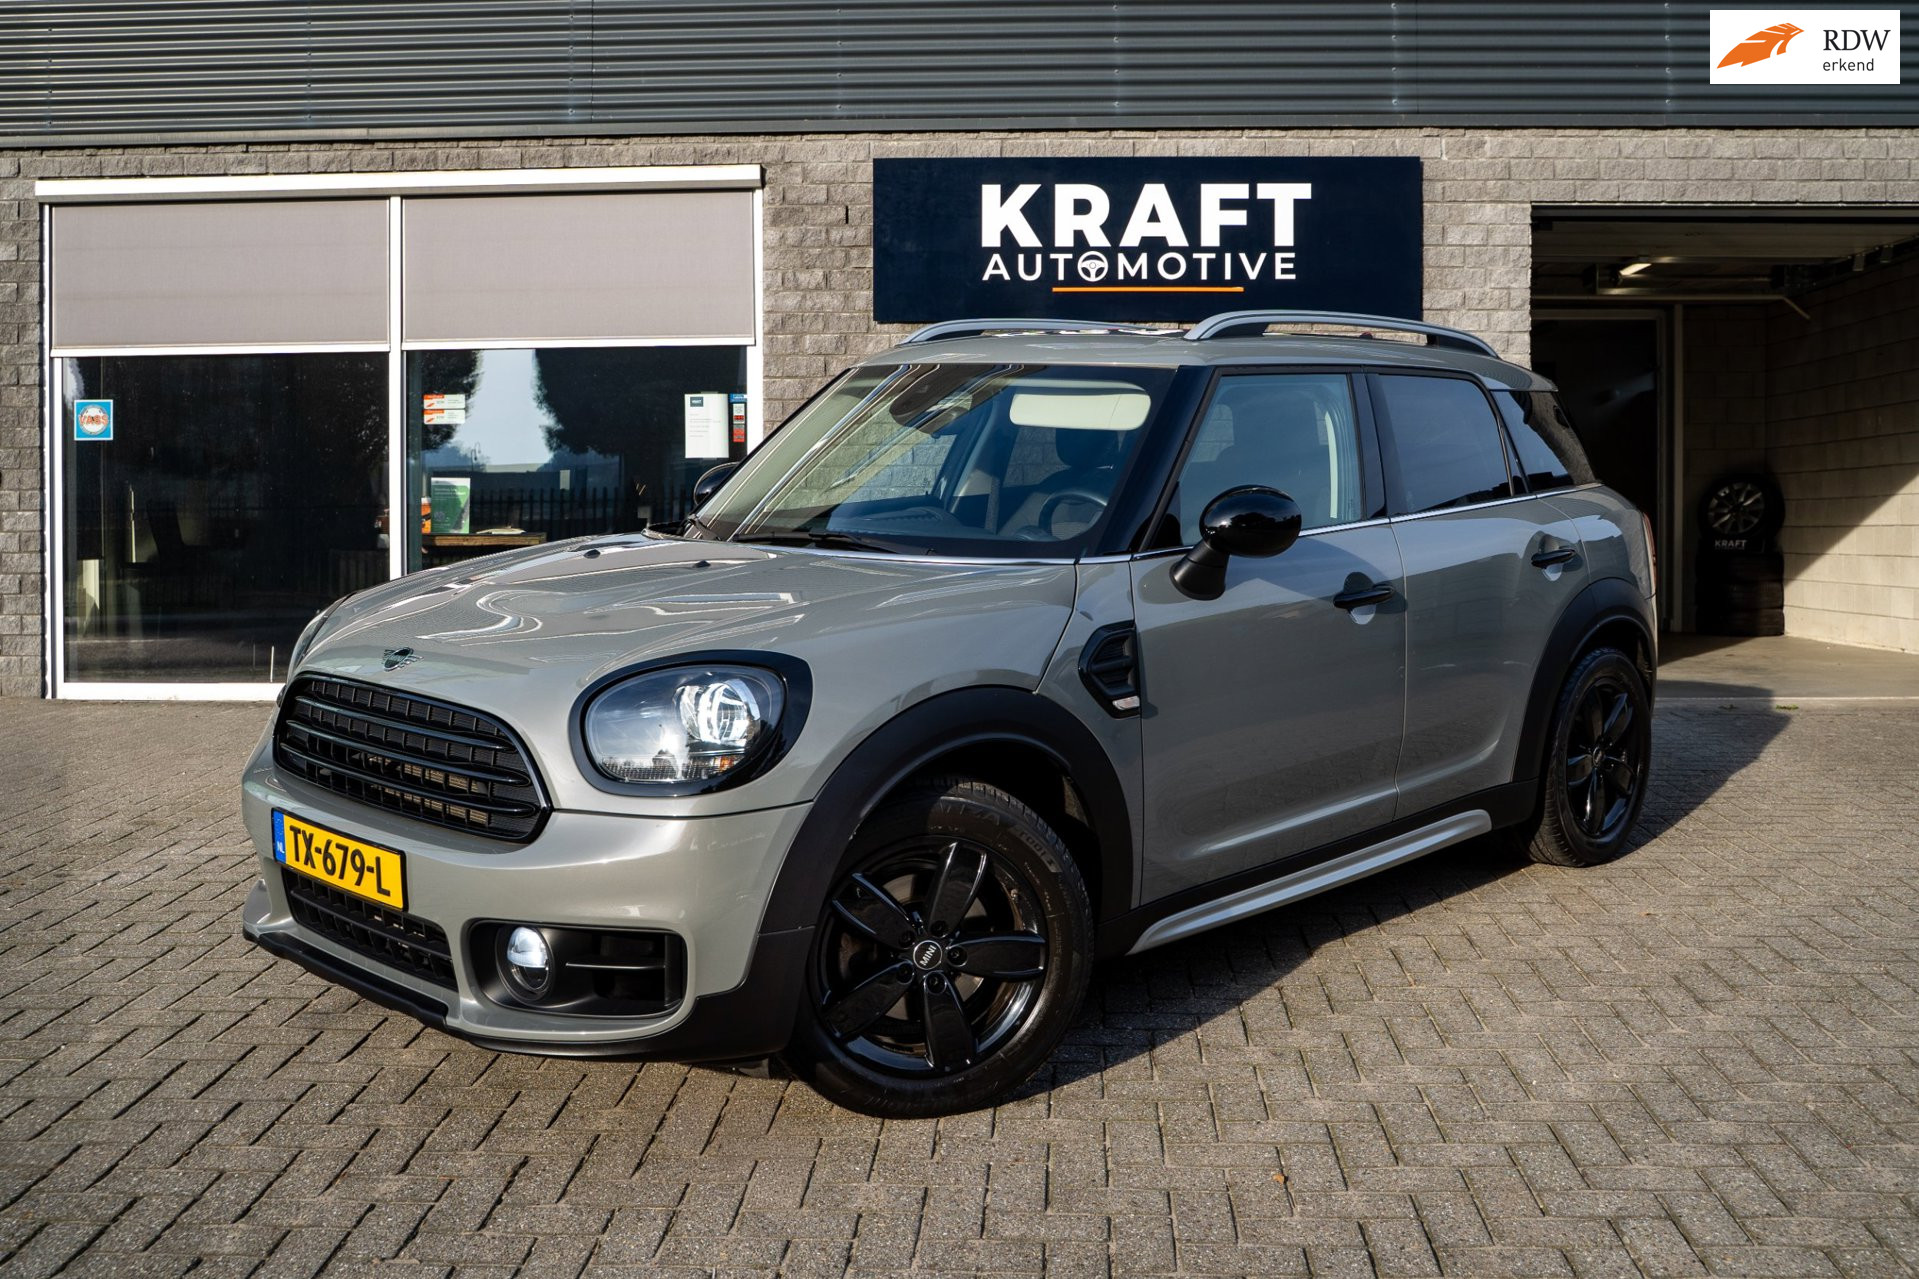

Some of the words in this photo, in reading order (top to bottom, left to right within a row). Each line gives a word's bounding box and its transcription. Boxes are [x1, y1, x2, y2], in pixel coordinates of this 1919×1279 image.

[981, 182, 1312, 248] KRAFT
[982, 250, 1297, 282] AUTOMOTIVE
[1714, 539, 1747, 547] KRAFT
[289, 824, 391, 897] TX-679-L
[919, 944, 937, 966] MINI
